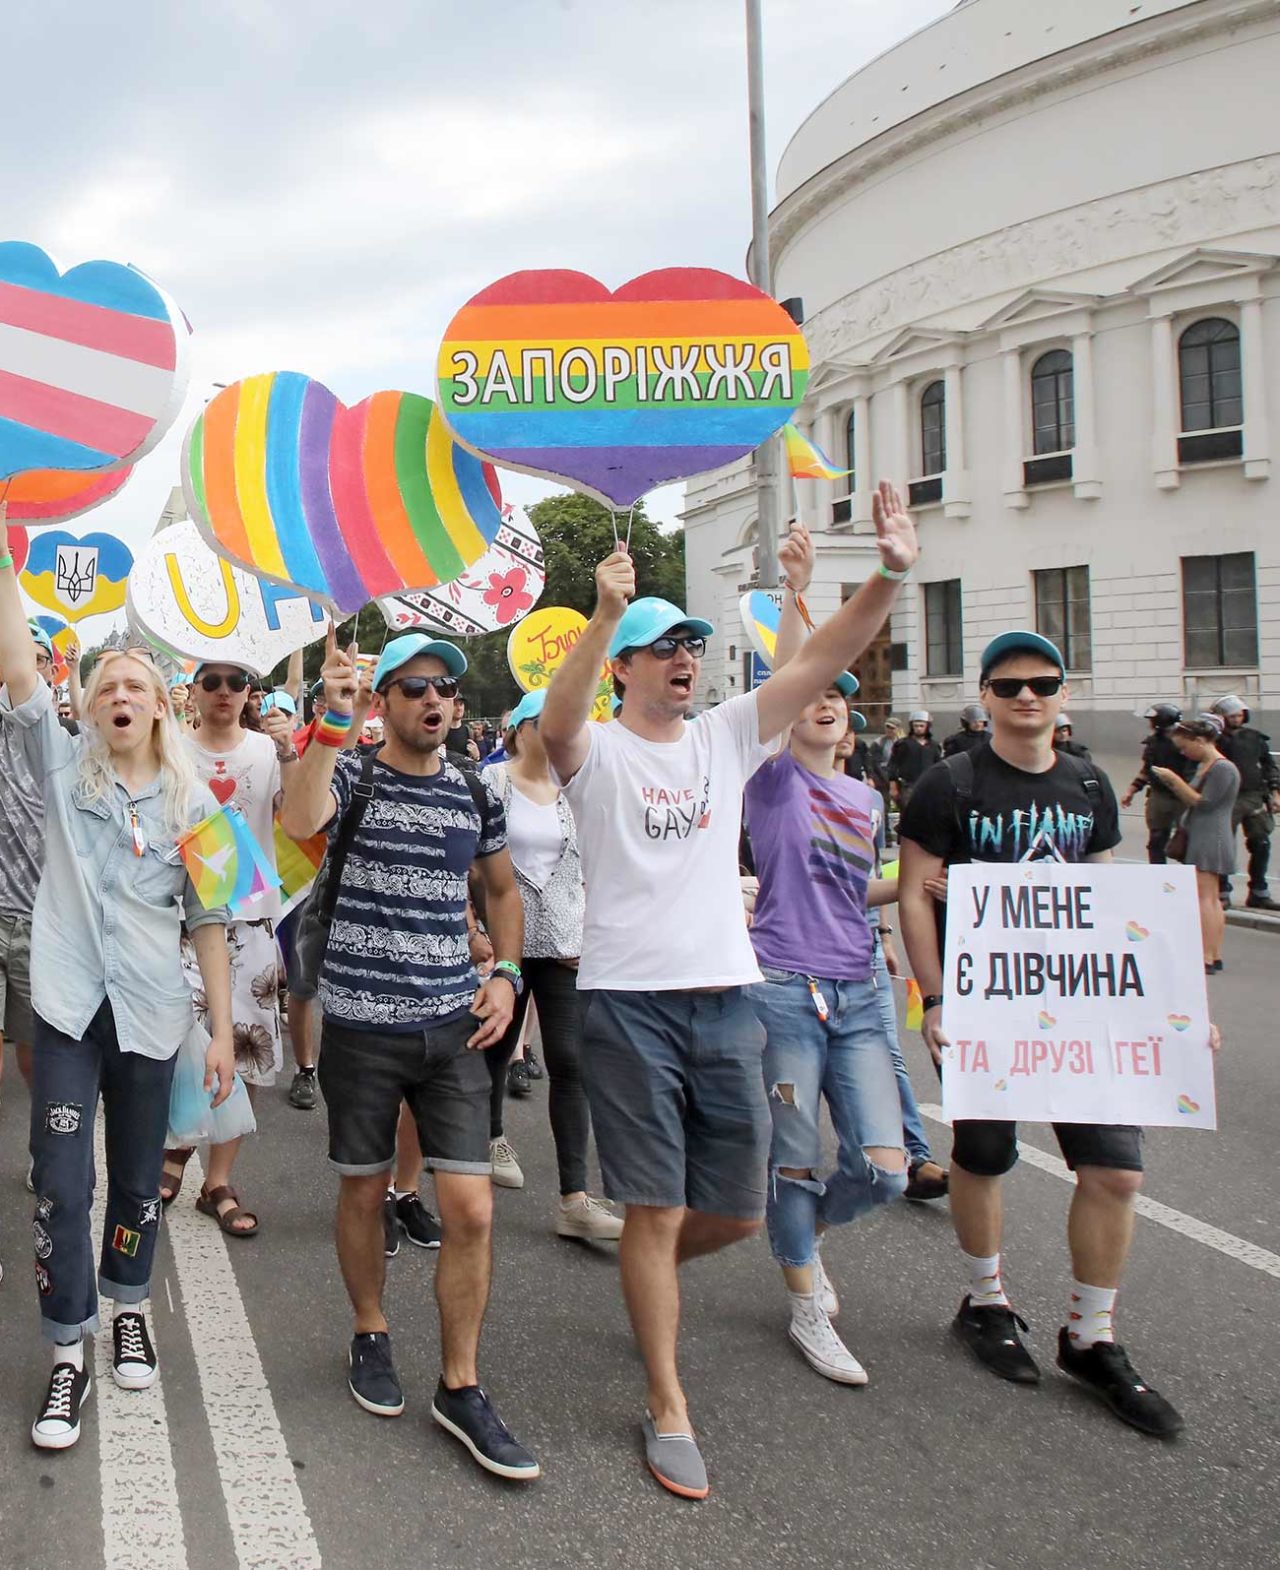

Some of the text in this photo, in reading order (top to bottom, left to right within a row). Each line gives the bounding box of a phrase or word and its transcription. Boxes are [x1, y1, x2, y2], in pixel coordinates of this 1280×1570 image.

[451, 343, 793, 406] ЗАПОРІЖЖЯ
[642, 786, 695, 806] HAVE
[645, 802, 696, 841] GAY
[972, 885, 1095, 930] У МЕНЕ
[956, 952, 1145, 1001] Є ДІВЧИНА
[956, 1035, 1164, 1077] ТА ДРУЗІ ГЕЇ
